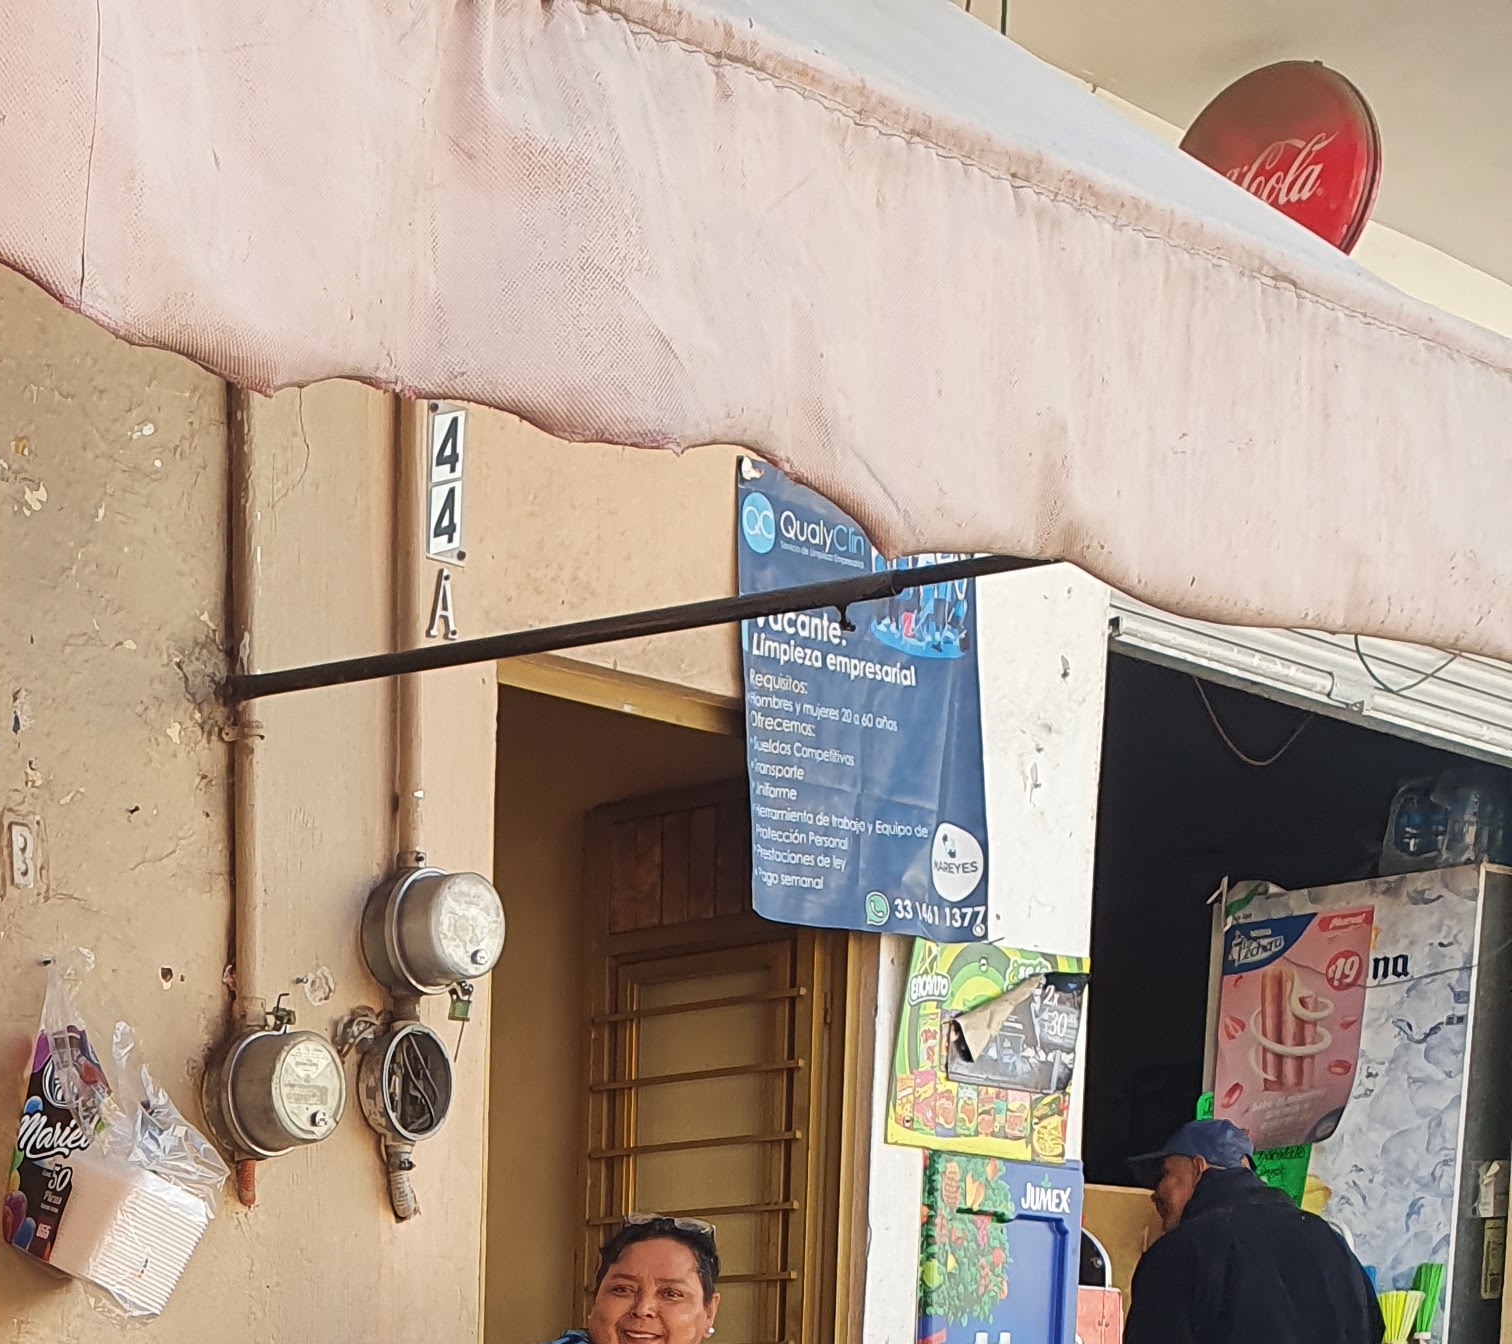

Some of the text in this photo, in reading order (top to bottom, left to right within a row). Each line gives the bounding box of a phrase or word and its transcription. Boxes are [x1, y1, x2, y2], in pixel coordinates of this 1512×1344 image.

[780, 510, 865, 556] QualyClin
[751, 632, 917, 687] Limpieza empresarial
[749, 668, 808, 695] Requisitos:
[750, 711, 816, 737] Ofrecemos:
[803, 703, 839, 720] mujeres
[841, 708, 852, 724] 20
[853, 714, 860, 725] a
[861, 713, 873, 728] 60
[875, 715, 898, 732] años
[793, 742, 856, 767] Competitivos
[756, 823, 849, 850] Protección Personal
[816, 812, 830, 827] de
[832, 815, 866, 835] trabajo
[867, 821, 874, 836] y
[875, 820, 913, 838] Equipo
[915, 824, 929, 838] de
[817, 853, 831, 867] de
[833, 855, 848, 873] ley
[780, 874, 824, 890] semanal
[894, 898, 913, 920] 33
[944, 905, 986, 929] 1377
[1021, 1181, 1071, 1214] JUMEX
